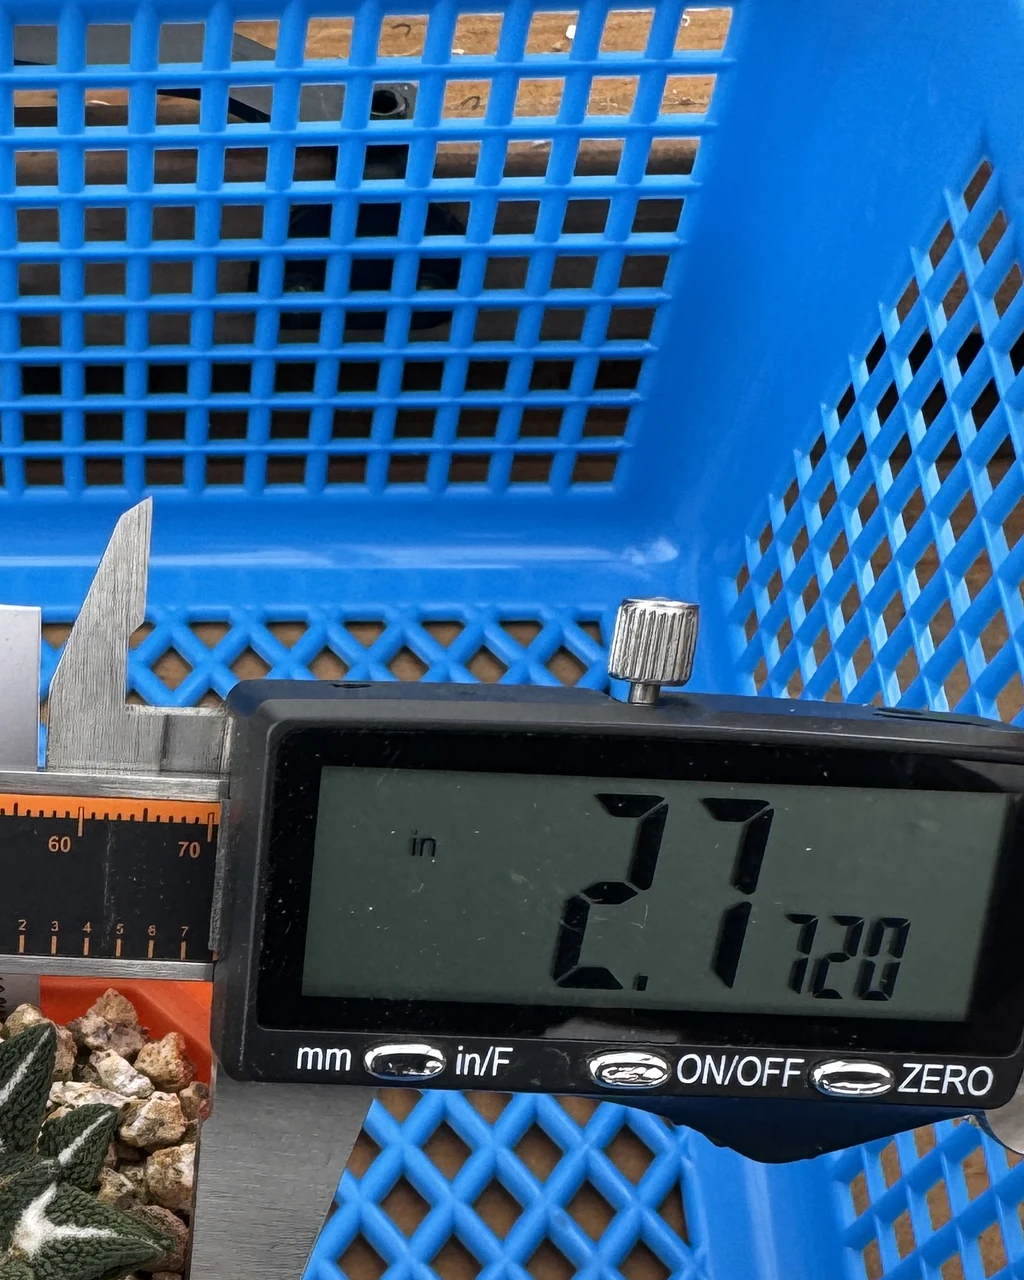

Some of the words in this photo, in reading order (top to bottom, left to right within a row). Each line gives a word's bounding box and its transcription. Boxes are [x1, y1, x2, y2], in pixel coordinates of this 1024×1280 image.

[48, 835, 71, 853] 60
[178, 841, 201, 858] 70
[408, 830, 437, 859] in
[553, 793, 912, 1000] 2.7720
[296, 1045, 353, 1073] mm
[454, 1046, 514, 1078] in/F
[676, 1056, 806, 1089] ON/OFF
[897, 1063, 993, 1096] ZERO
